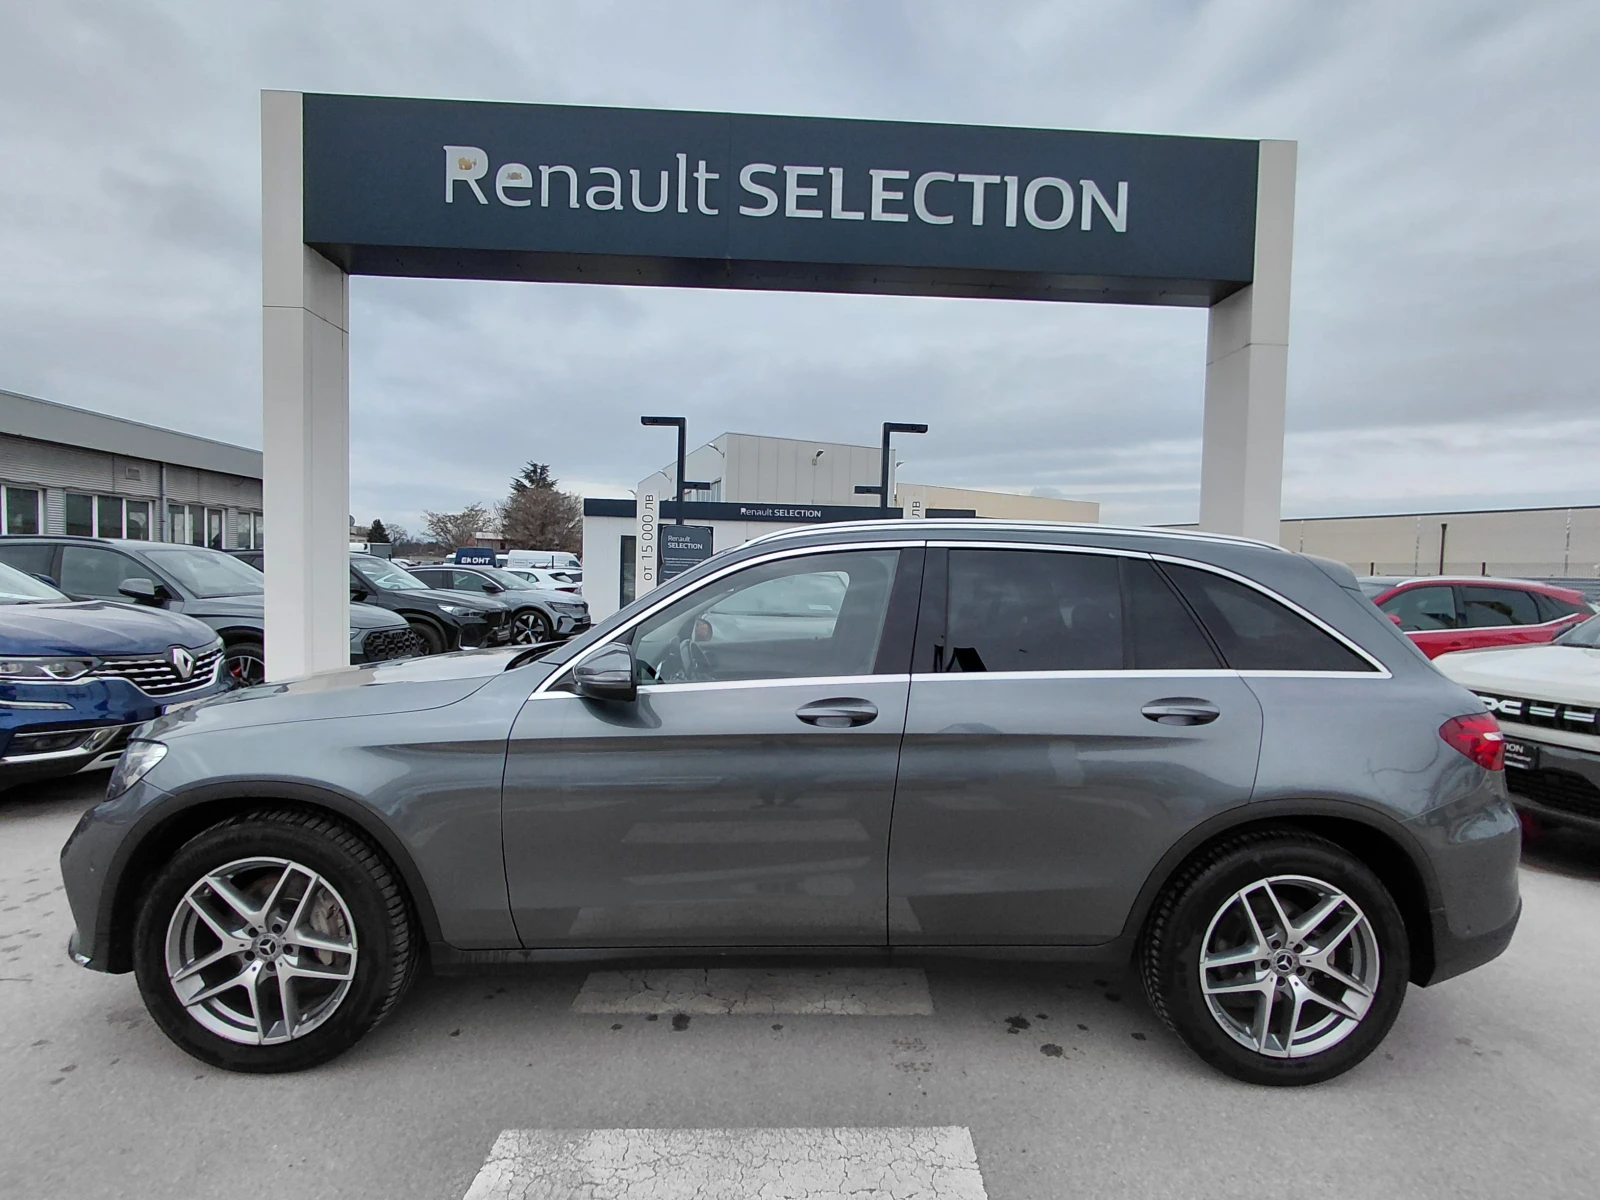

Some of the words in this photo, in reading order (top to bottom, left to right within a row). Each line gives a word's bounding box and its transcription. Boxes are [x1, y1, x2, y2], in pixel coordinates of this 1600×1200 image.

[442, 144, 720, 216] Renault
[738, 162, 1128, 234] SELECTION
[740, 507, 773, 517] Renault
[774, 508, 822, 518] SELECTION
[641, 514, 654, 541] 000
[641, 545, 653, 560] 15
[667, 542, 703, 550] SELECTION
